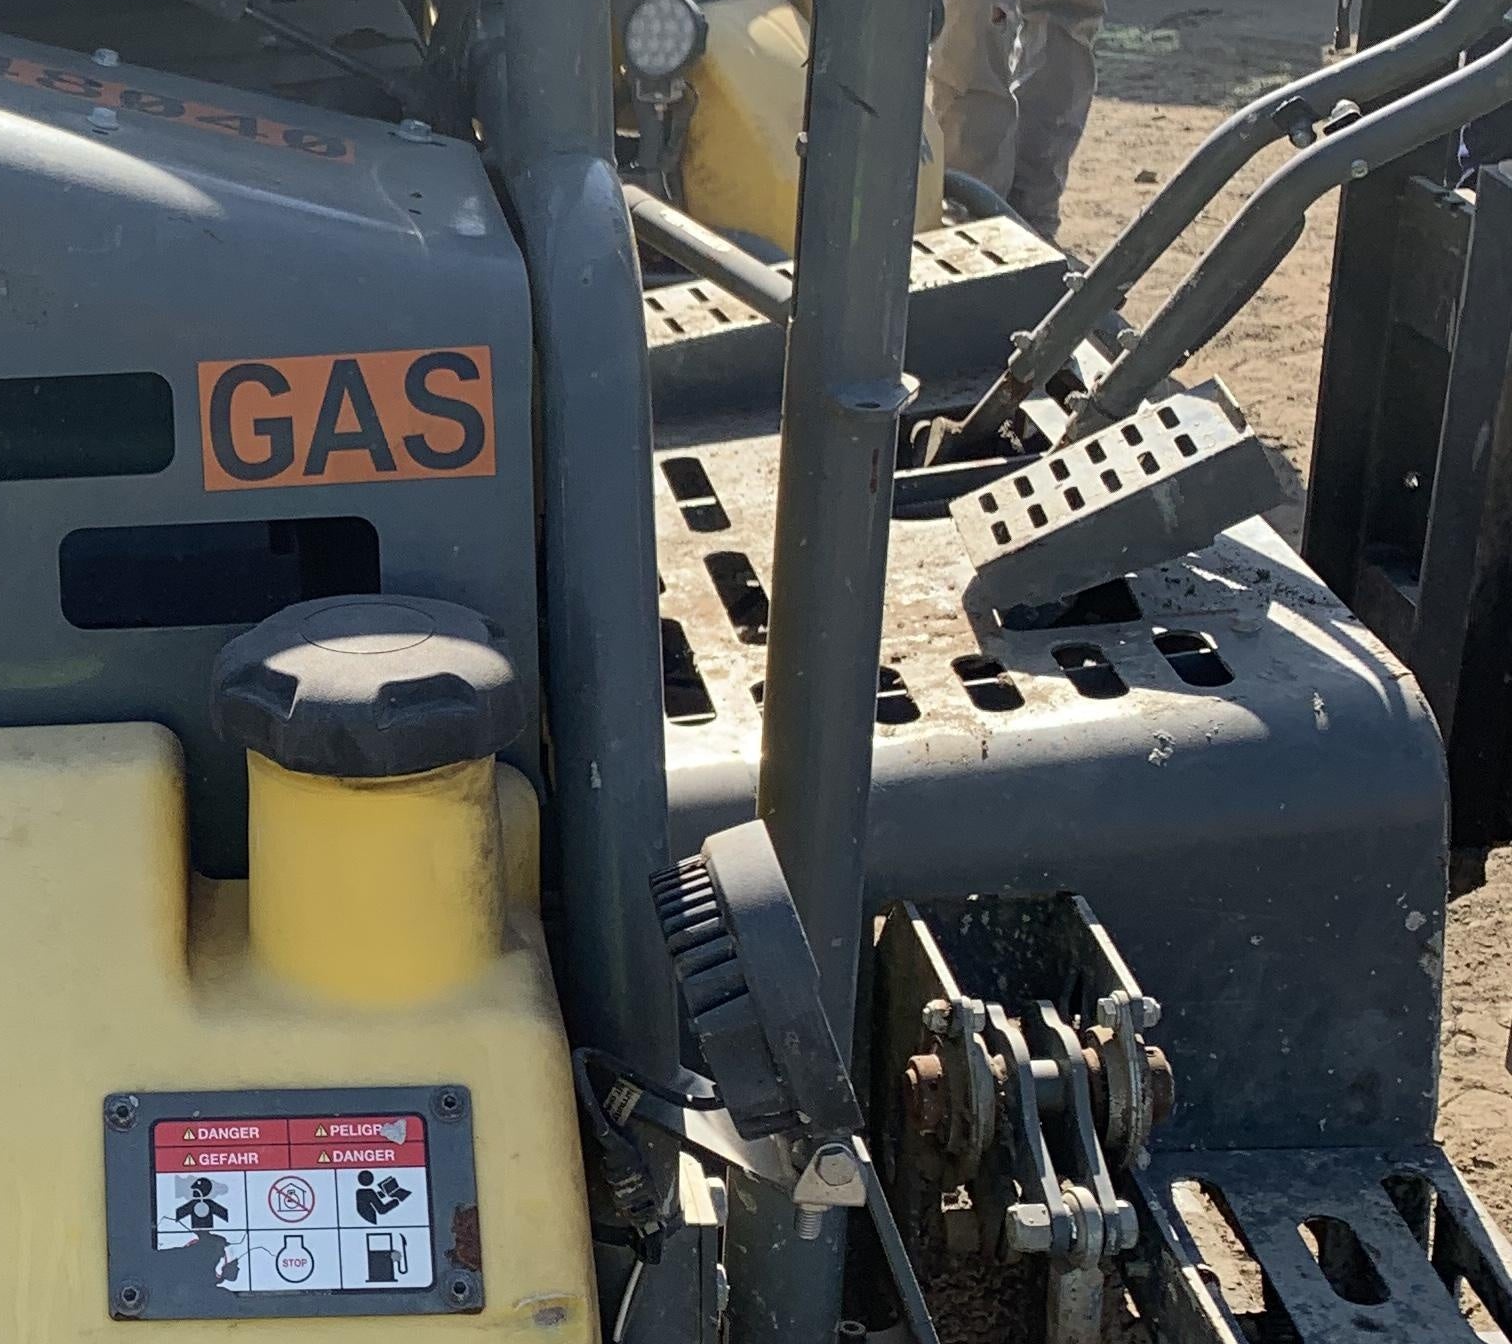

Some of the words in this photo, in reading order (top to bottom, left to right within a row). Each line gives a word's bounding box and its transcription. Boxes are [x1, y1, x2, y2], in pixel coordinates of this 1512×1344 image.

[209, 351, 486, 483] GAS
[197, 1127, 260, 1140] DANGER
[329, 1124, 387, 1138] PELIGR
[198, 1152, 259, 1166] GEFAHR
[332, 1149, 395, 1163] DANGER
[281, 1258, 308, 1268] STOP
